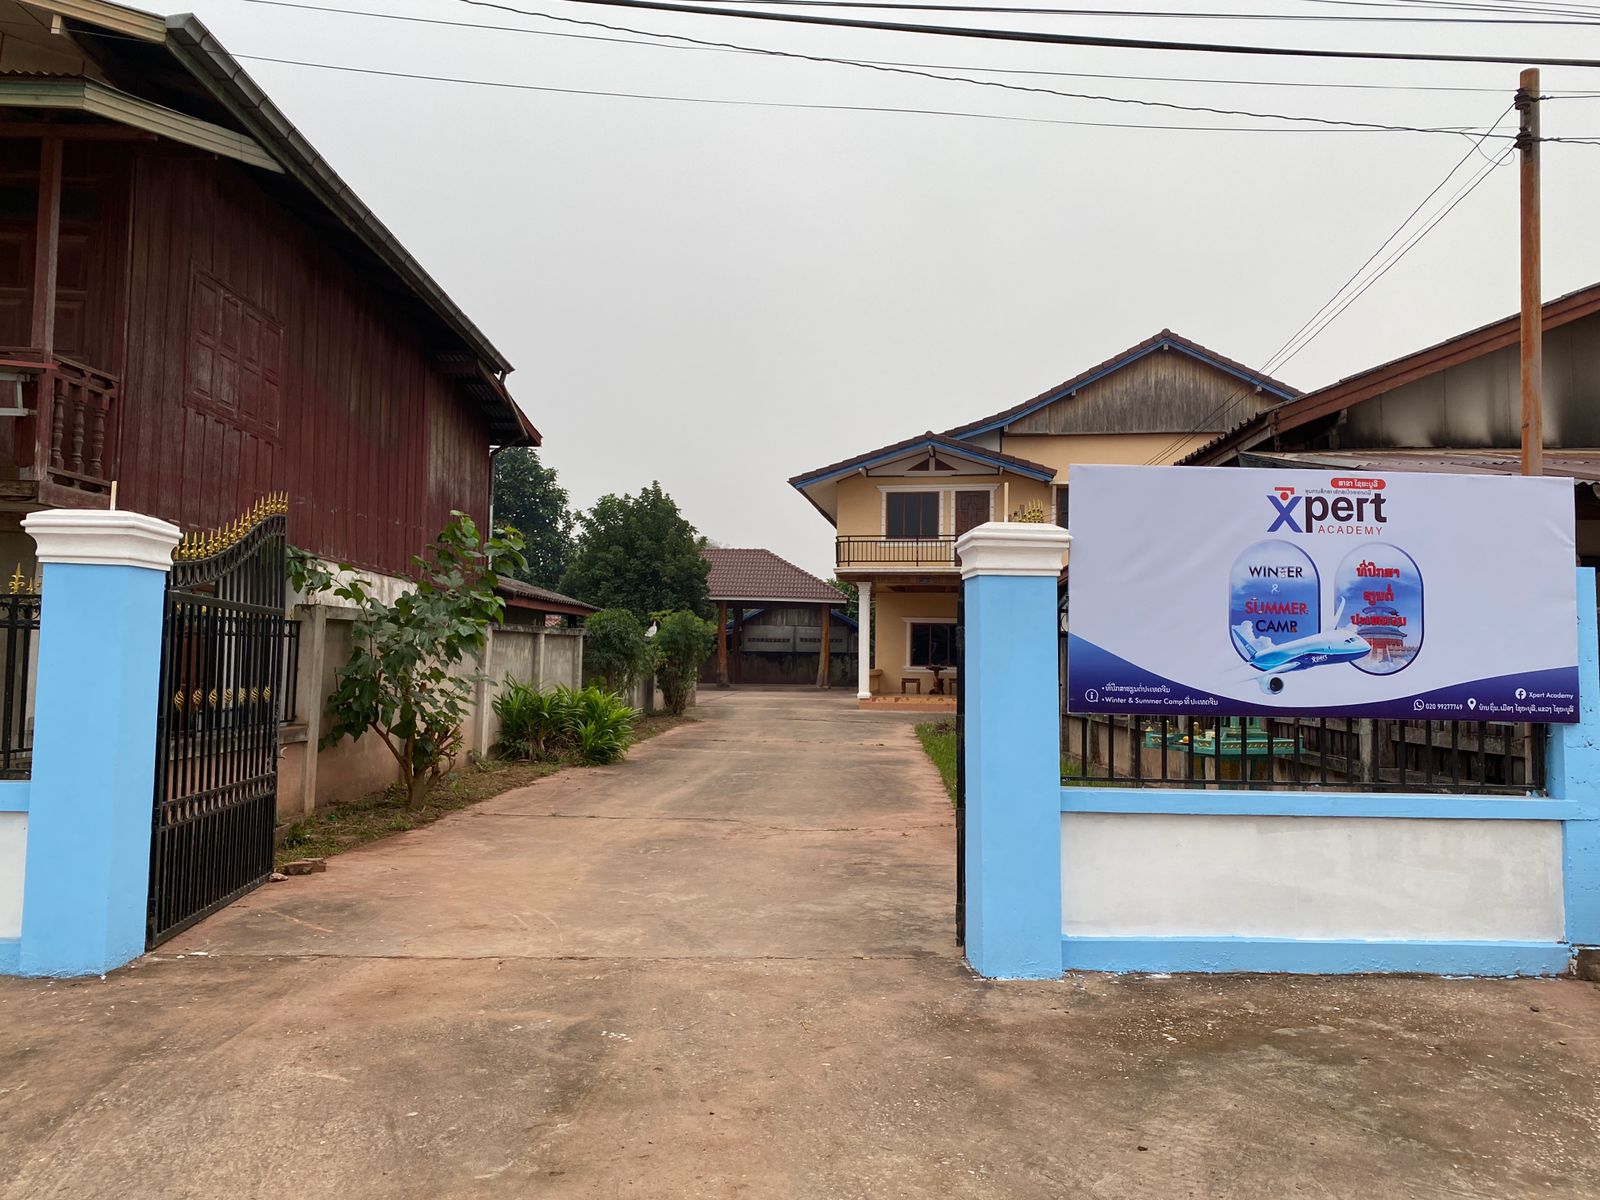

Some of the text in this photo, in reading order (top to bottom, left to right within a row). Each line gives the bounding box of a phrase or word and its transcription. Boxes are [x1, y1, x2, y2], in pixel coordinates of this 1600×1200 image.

[1266, 493, 1388, 533] Xpert
[1318, 525, 1383, 536] ACADEMY
[1245, 600, 1308, 615] SUMMER
[1255, 620, 1298, 633] CAMP
[1528, 691, 1574, 700] Xpert Academy
[1163, 698, 1184, 706] Camp
